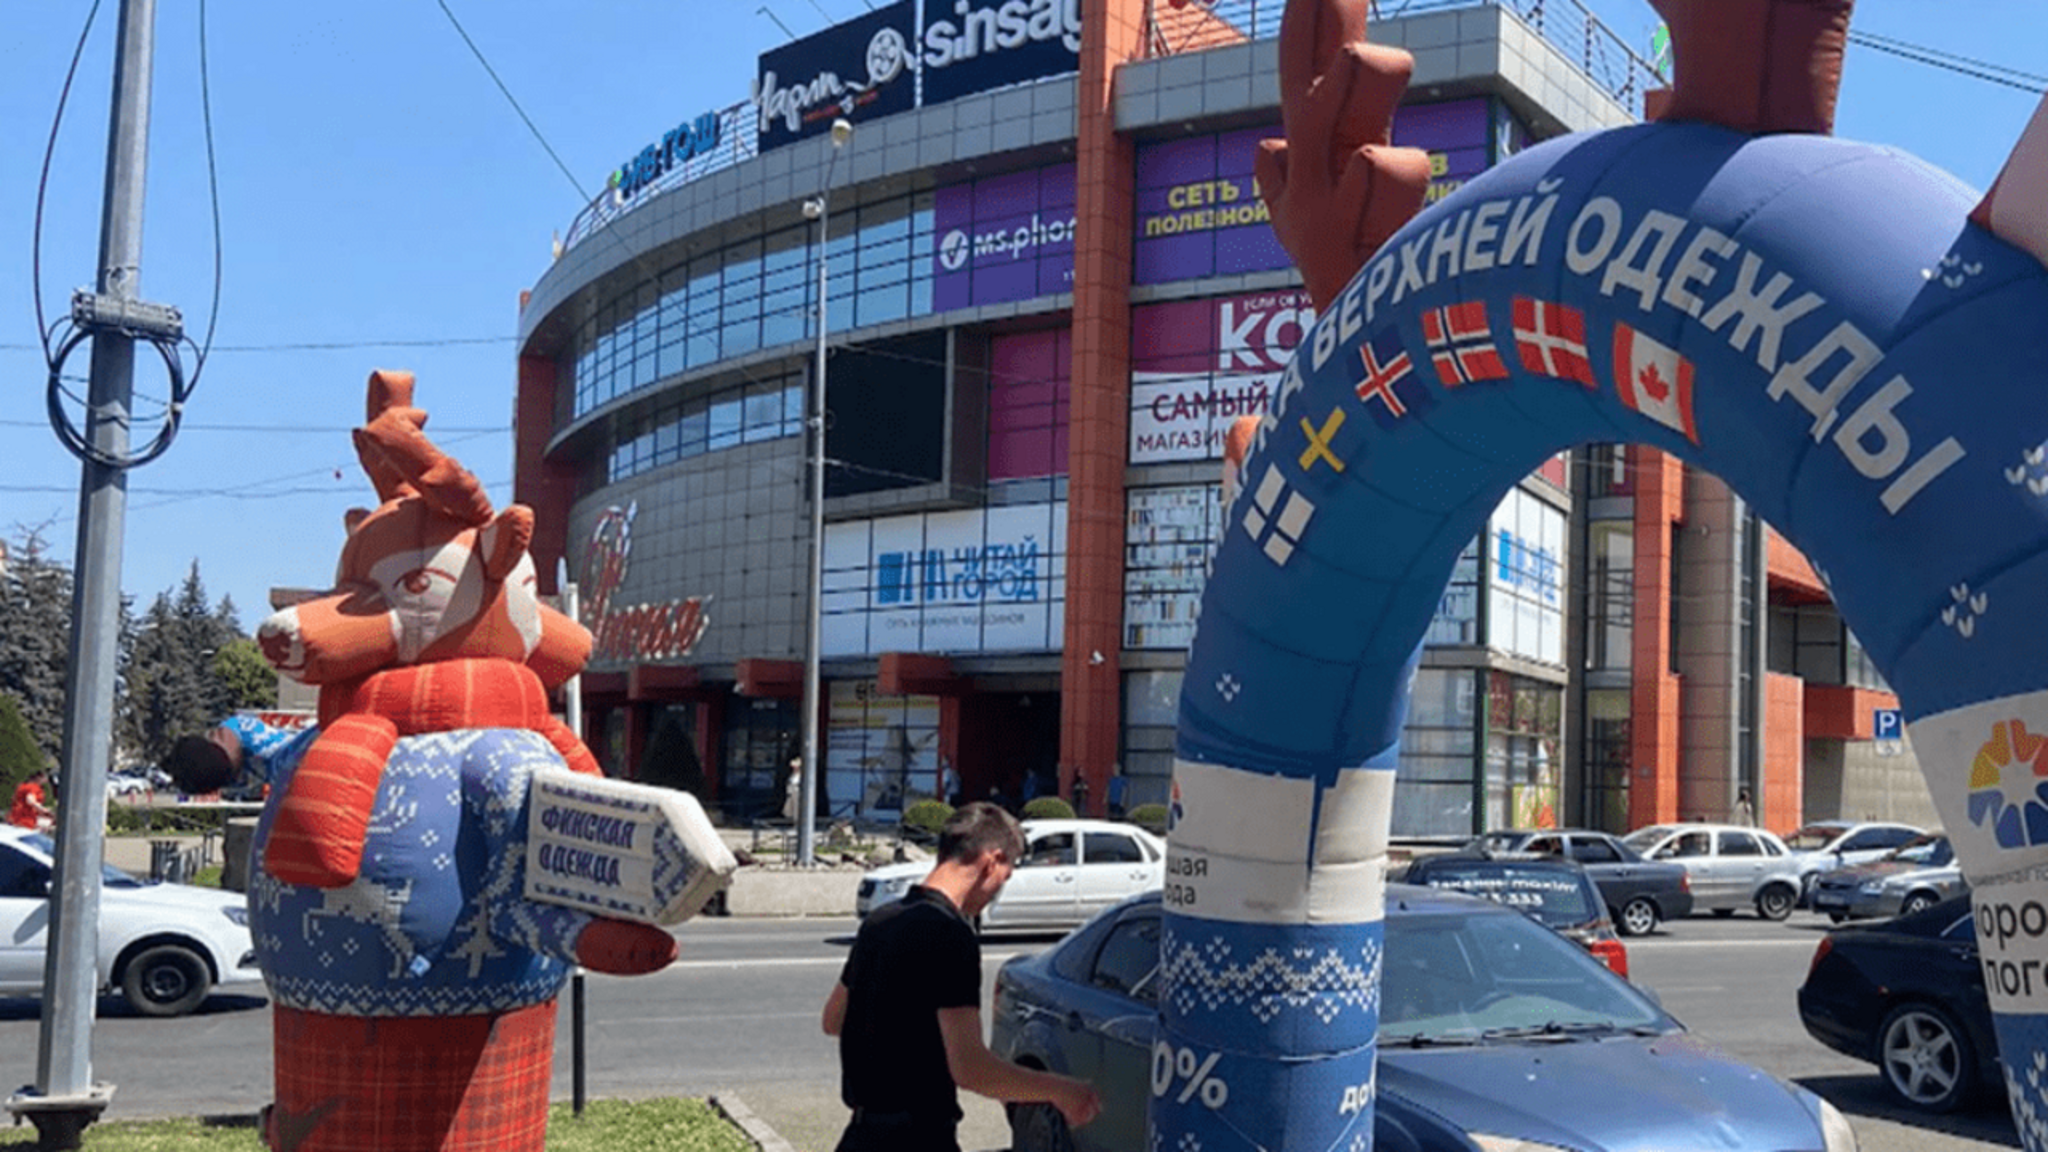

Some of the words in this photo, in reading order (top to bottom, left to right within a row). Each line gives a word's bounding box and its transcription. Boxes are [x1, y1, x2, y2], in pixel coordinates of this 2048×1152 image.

[1168, 180, 1239, 209] СЕТЬ
[1146, 198, 1271, 236] ПОЛЕЗНОЙ
[1312, 178, 1563, 372] ВЕРХНЕЙ
[1566, 196, 1967, 515] ОДЕЖДЫ
[1153, 380, 1268, 422] САМЫЙ
[955, 534, 1037, 572] ЧИТАЙ
[952, 569, 1038, 602] ГОРОД
[541, 804, 638, 849] ФИНСКАЯ
[538, 843, 621, 887] ОДЕЖДА
